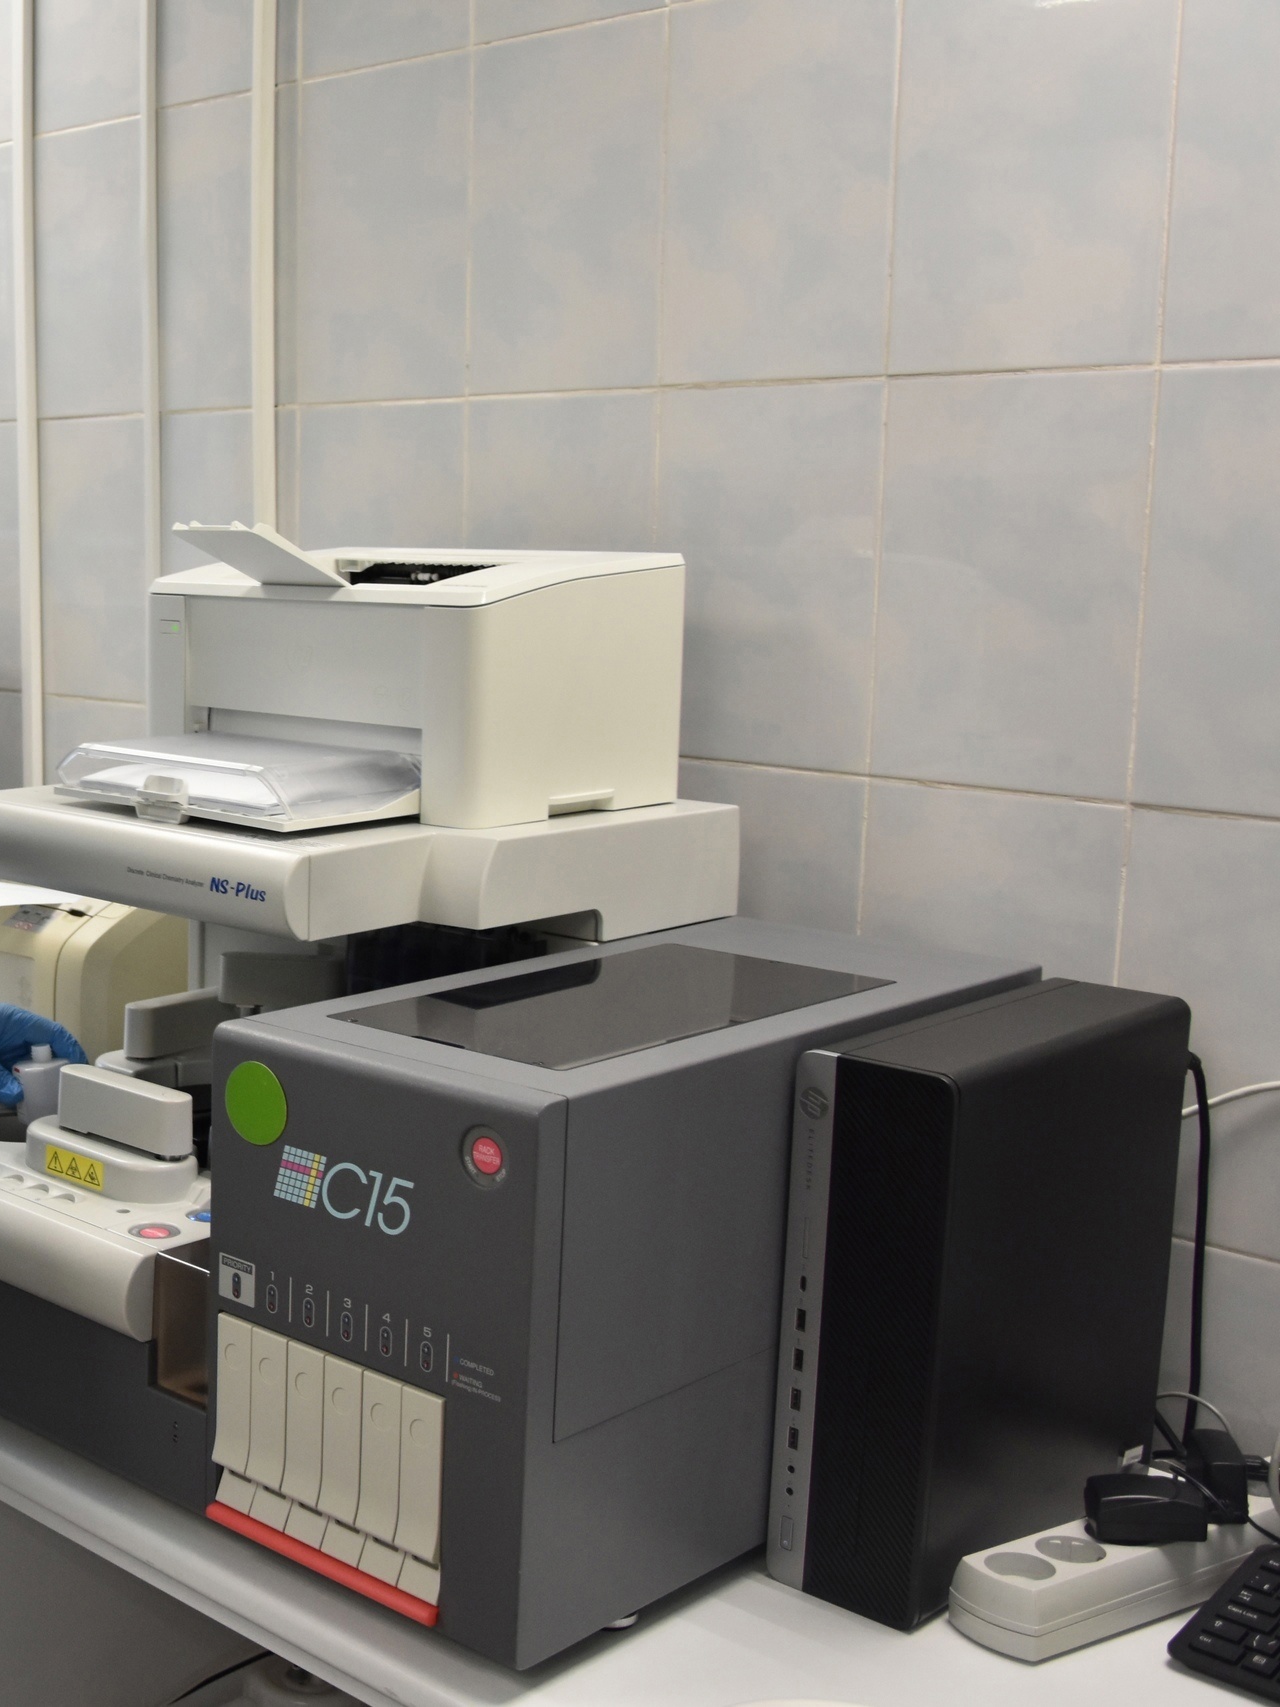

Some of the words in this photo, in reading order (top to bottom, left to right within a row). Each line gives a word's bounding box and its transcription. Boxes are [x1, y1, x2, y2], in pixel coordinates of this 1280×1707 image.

[209, 876, 267, 902] NS-Plus
[322, 1162, 415, 1236] C15
[223, 1257, 252, 1274] PRIORITY
[270, 1271, 275, 1281] 1
[305, 1284, 314, 1295] 2
[343, 1298, 352, 1309] 3
[382, 1313, 391, 1323] 4
[423, 1327, 432, 1338] 5
[459, 1358, 495, 1376] COMPLETED
